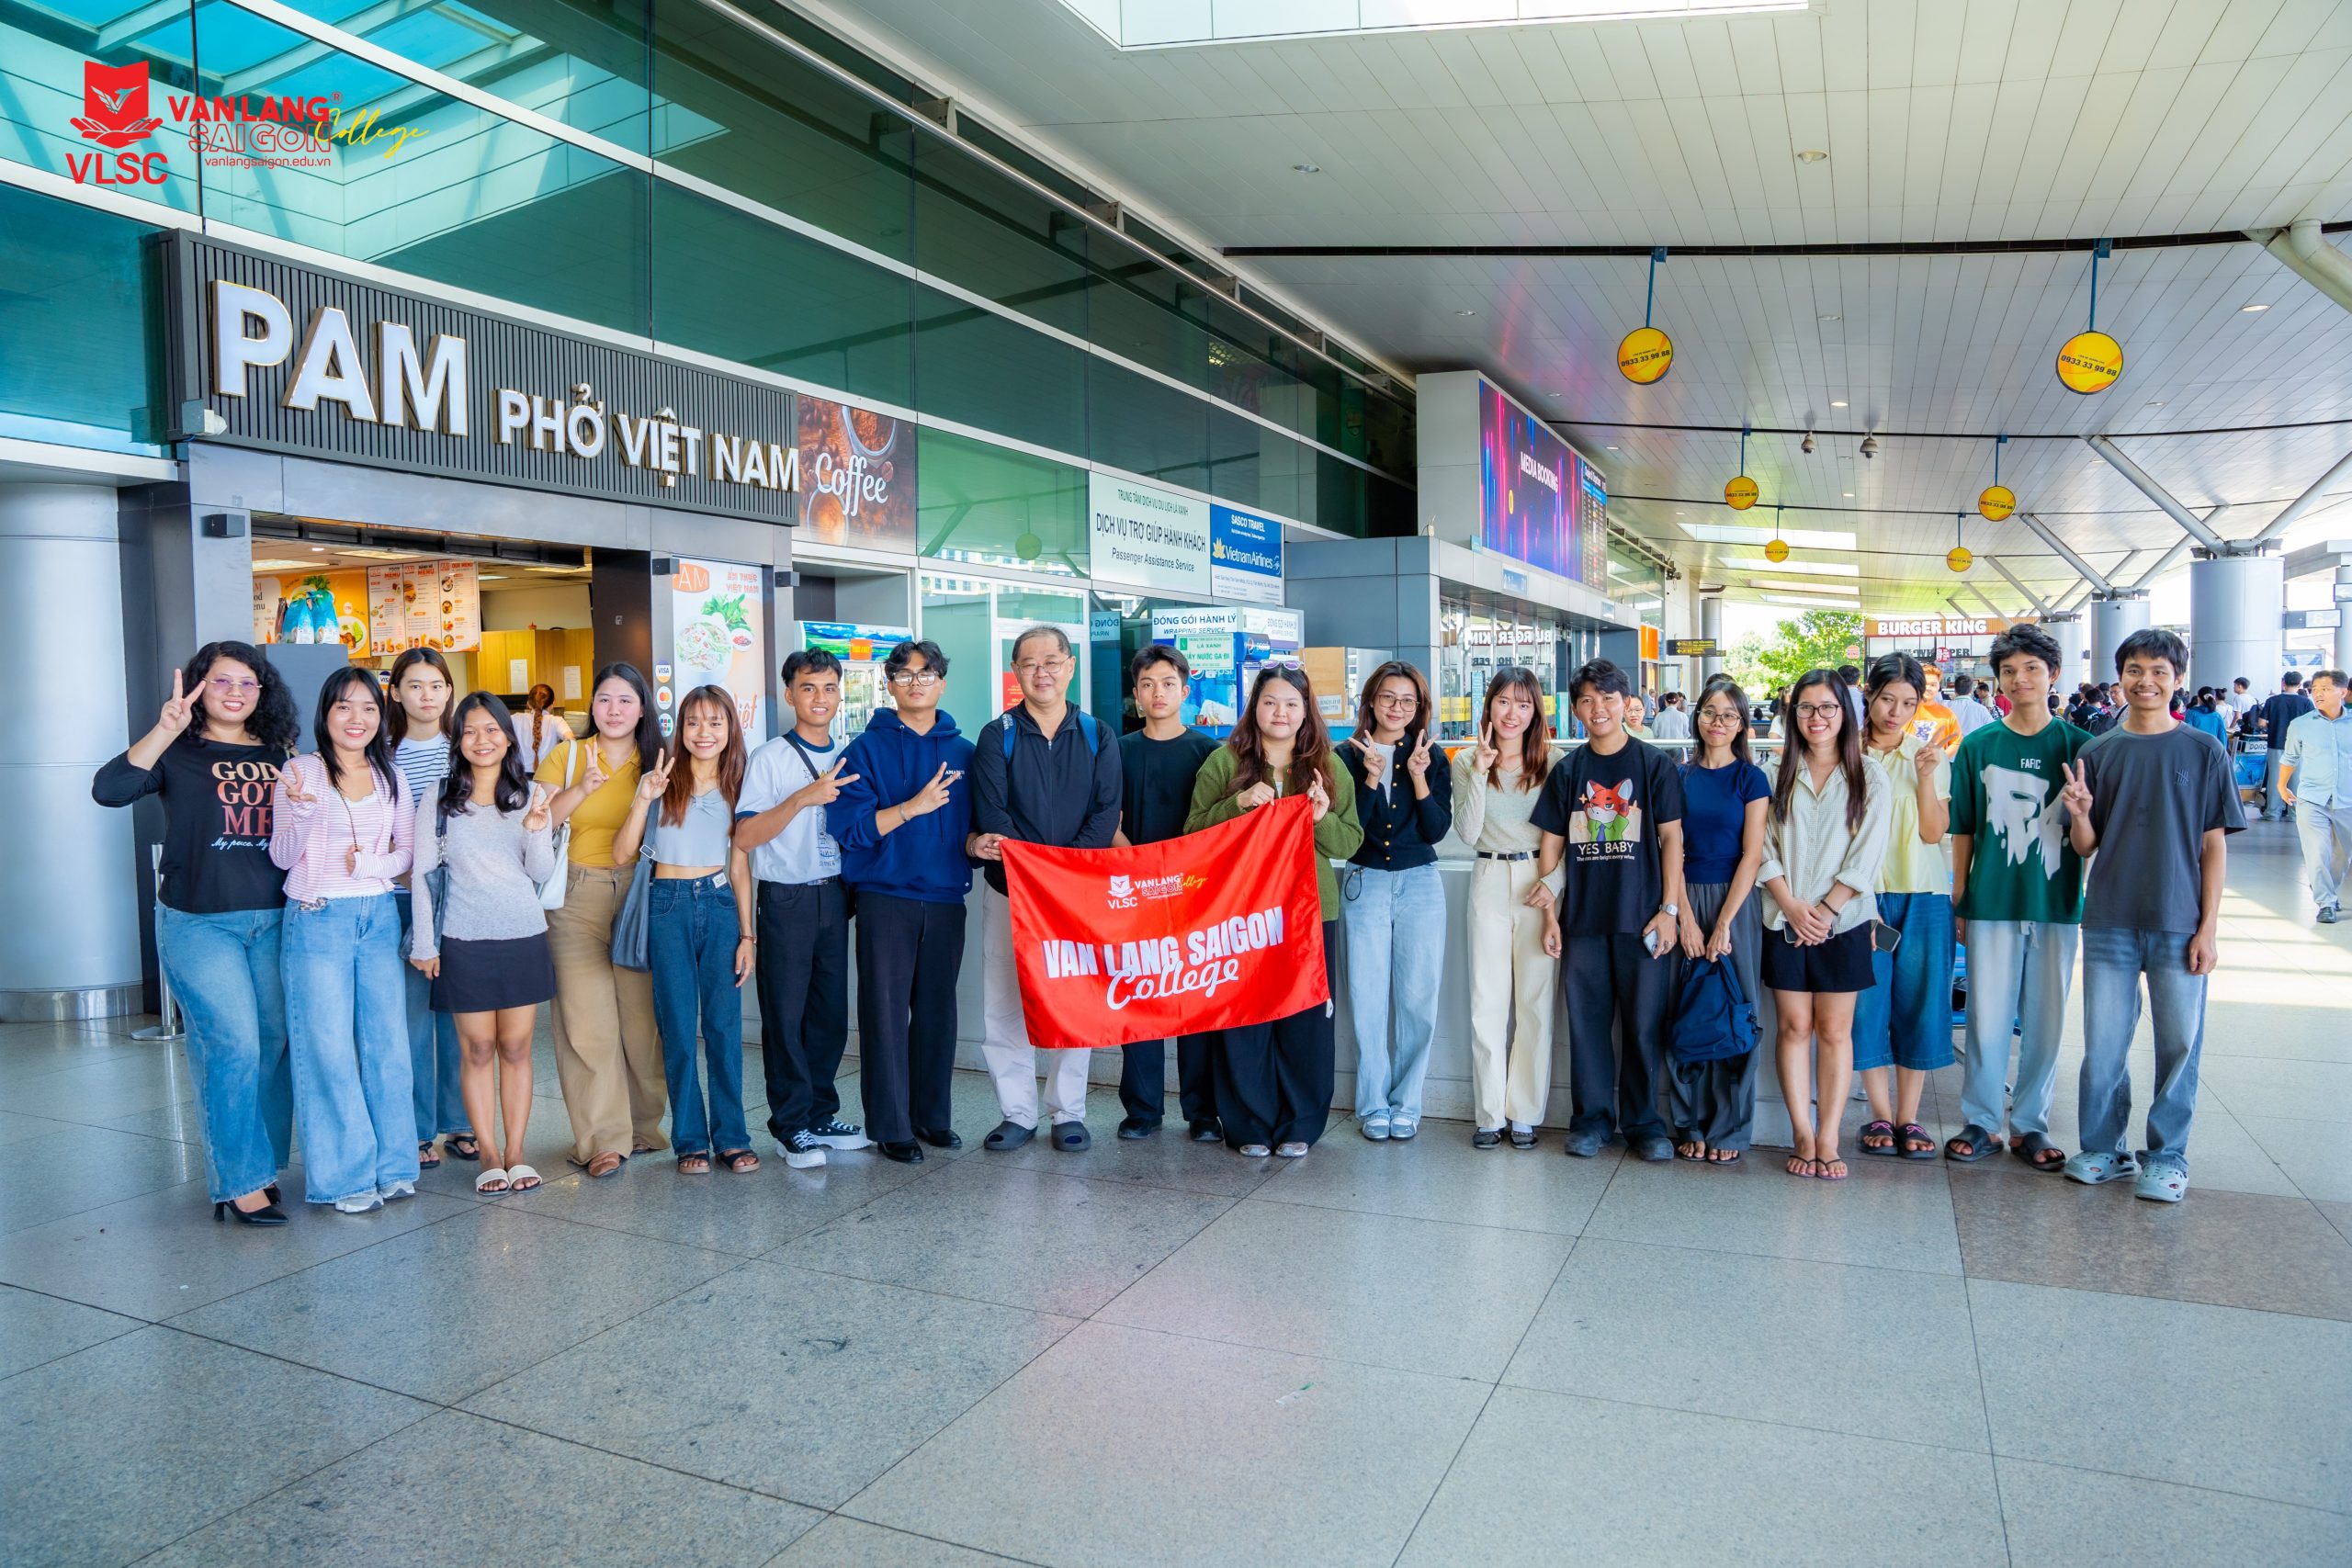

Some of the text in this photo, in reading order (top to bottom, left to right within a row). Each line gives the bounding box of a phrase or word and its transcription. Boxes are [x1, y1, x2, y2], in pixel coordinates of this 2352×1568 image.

[212, 279, 469, 436] PAM
[493, 383, 799, 492] PHỞ VIỆT NAM
[815, 452, 888, 516] Coffee
[1521, 451, 1537, 479] MEDIA
[1537, 462, 1558, 493] BOOKING
[1118, 489, 1132, 502] TRUNG
[1133, 491, 1142, 504] TÂM
[1096, 513, 1114, 537] DỊCH
[1116, 519, 1127, 540] VỤ
[1129, 520, 1145, 544] TRỢ
[1146, 521, 1162, 544] GIÚP
[1164, 523, 1182, 548] HÀNH
[1184, 531, 1205, 553] KHÁCH
[1231, 513, 1265, 533] SASCO TRAVEL
[1112, 547, 1194, 572] Passenger Assistance Service
[673, 565, 708, 591] AM
[1153, 613, 1237, 625] ĐÓNG GÓI HÀNH LÝ
[1877, 619, 1987, 636] BURGER KING
[211, 761, 279, 781] GOD
[217, 781, 277, 806] GOT
[220, 805, 274, 837] ME
[210, 837, 228, 851] My
[1577, 841, 1634, 855] YES BABY
[1107, 897, 1138, 909] VLSC
[1042, 906, 1284, 979] VAN LANG SAIGON
[1105, 957, 1240, 1010] College
